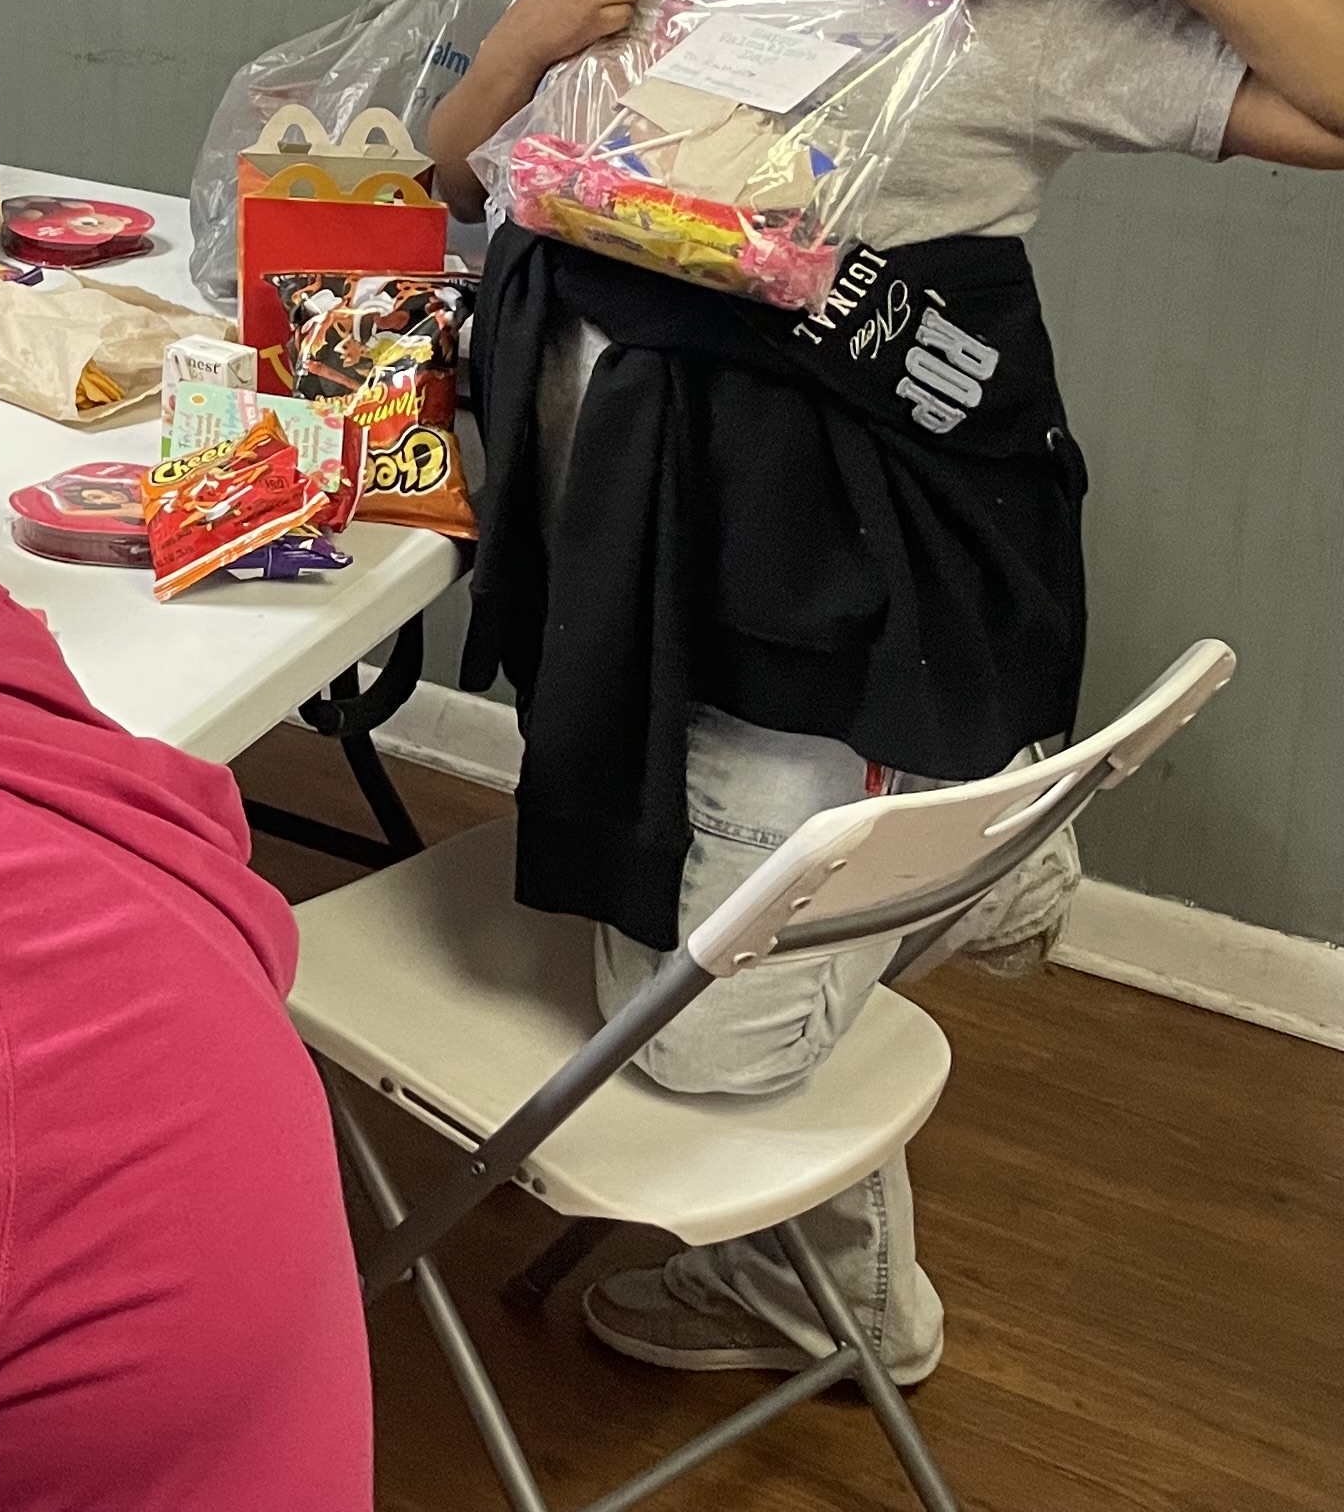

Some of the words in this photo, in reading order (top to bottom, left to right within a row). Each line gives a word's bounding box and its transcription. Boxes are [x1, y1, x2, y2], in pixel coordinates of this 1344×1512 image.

[792, 249, 887, 345] IGINAL
[849, 280, 910, 360] New
[151, 438, 235, 486] Cheet
